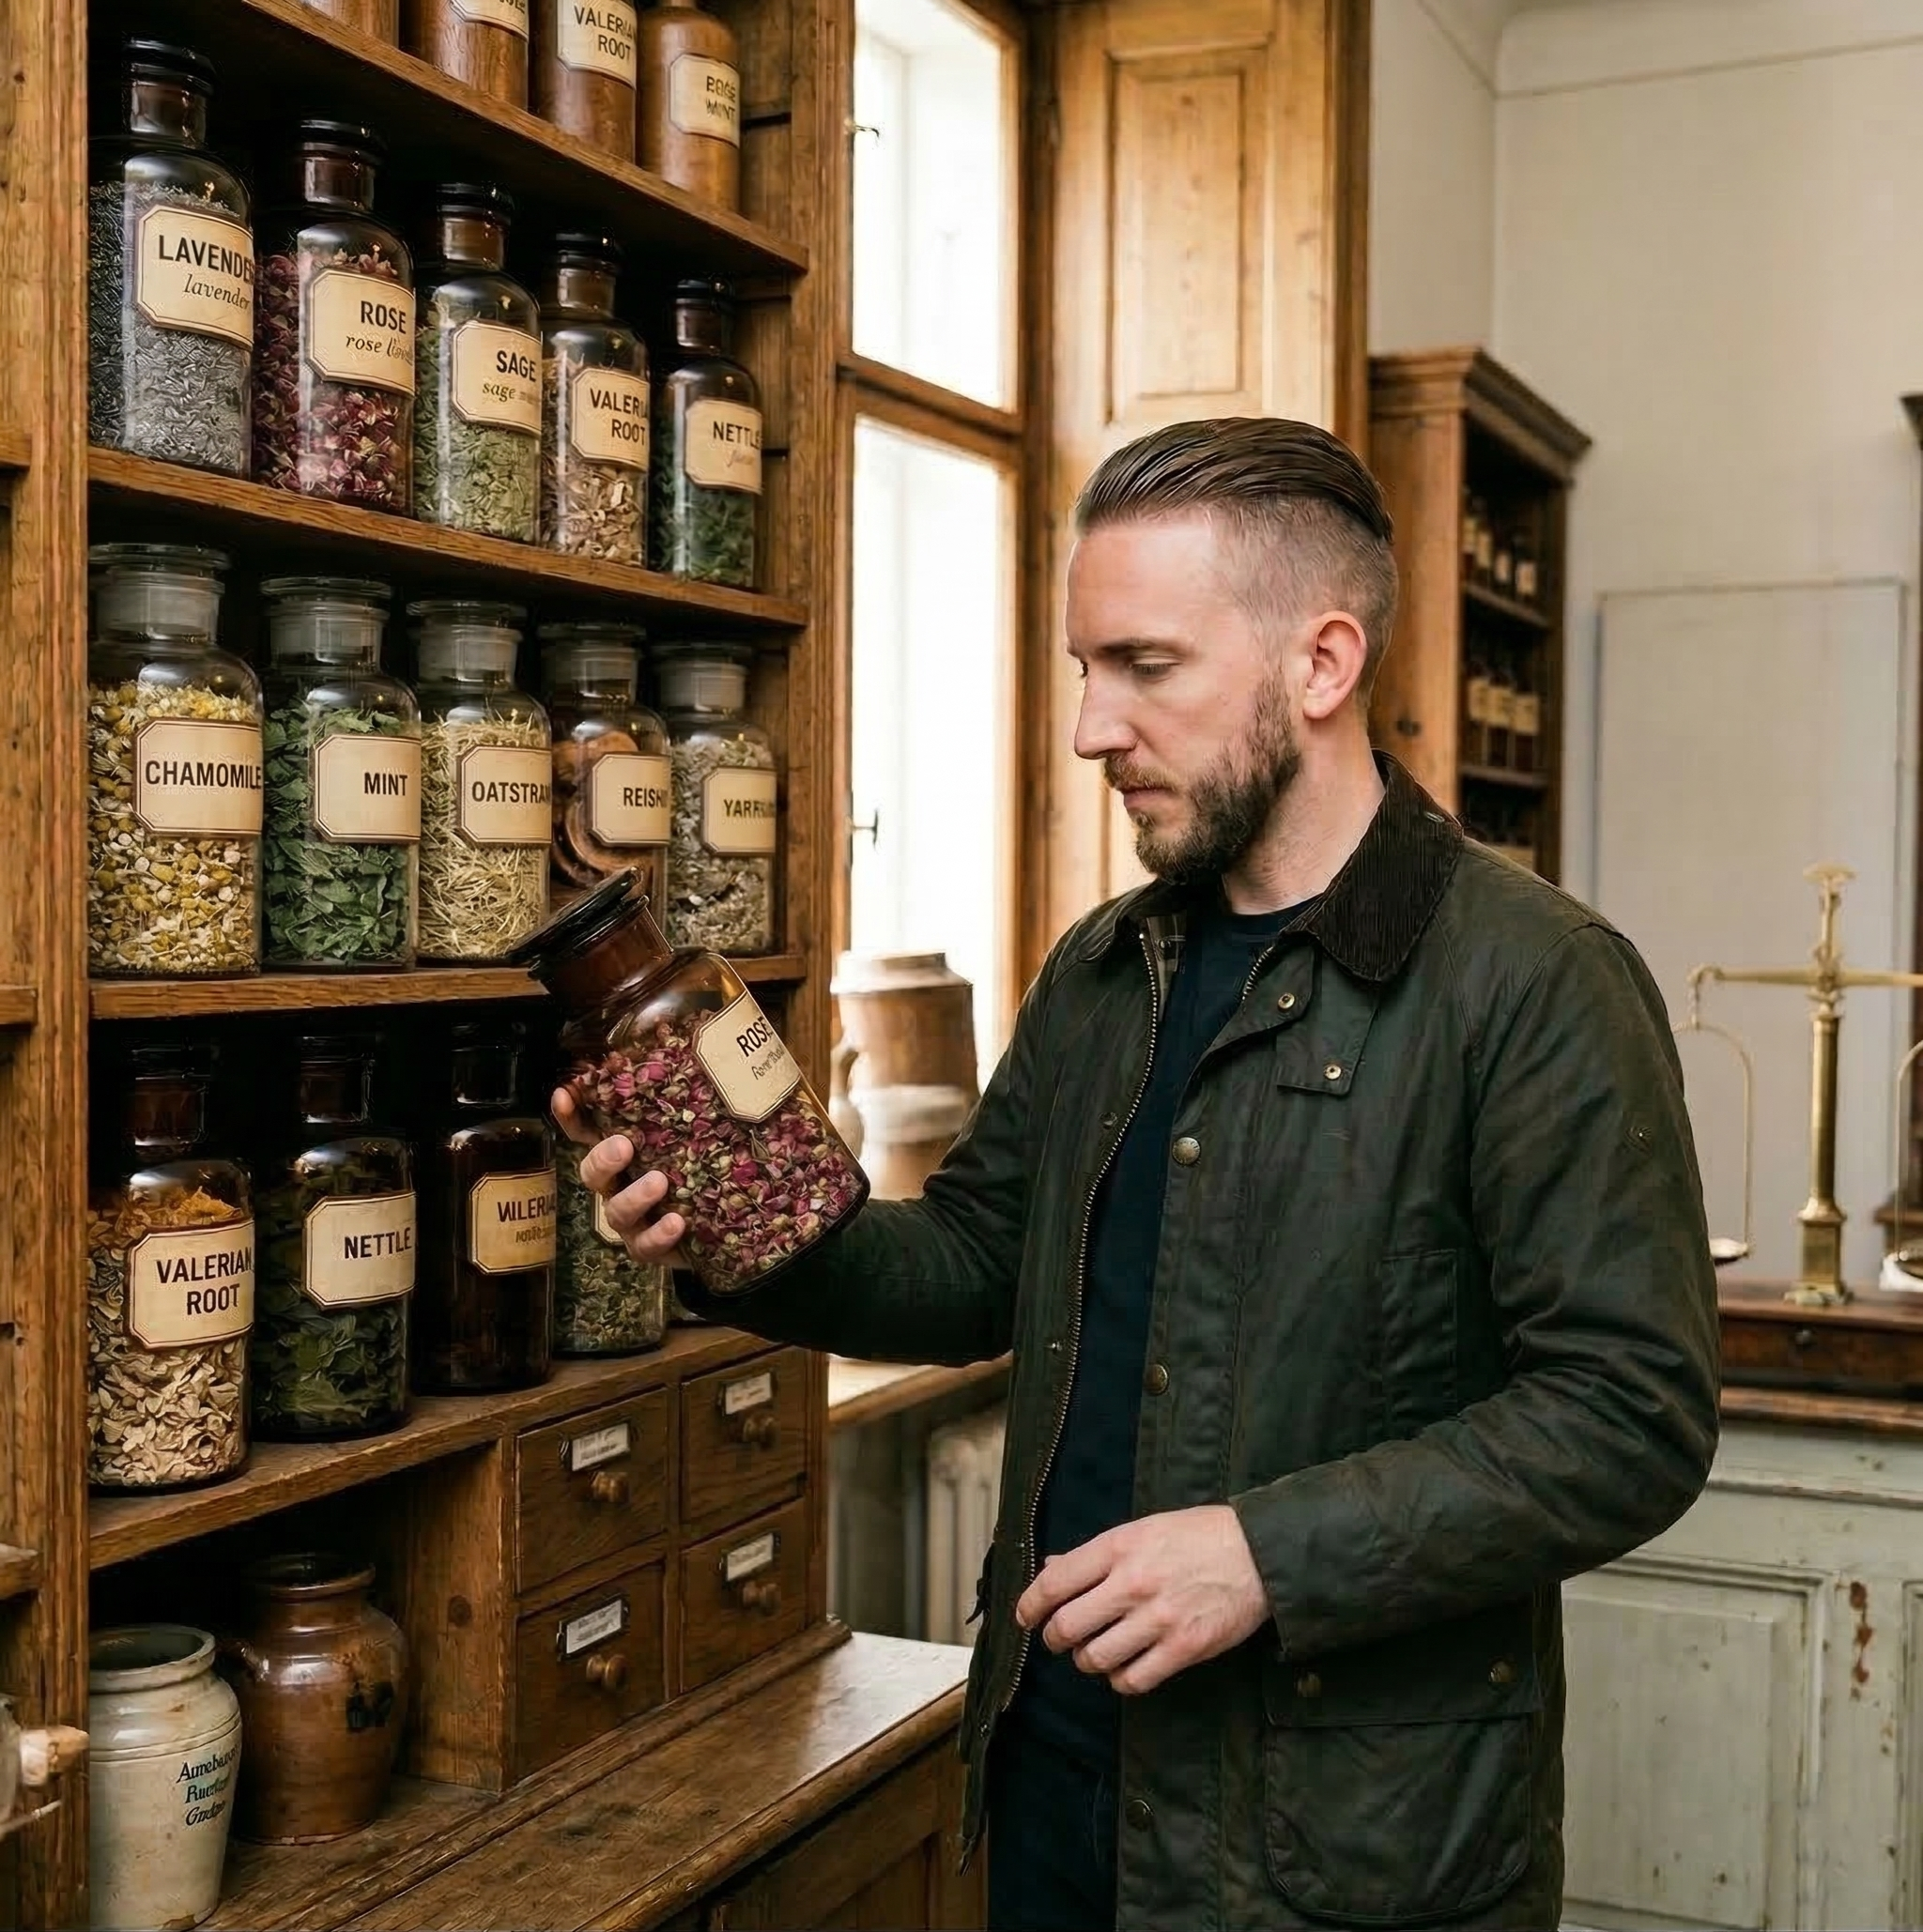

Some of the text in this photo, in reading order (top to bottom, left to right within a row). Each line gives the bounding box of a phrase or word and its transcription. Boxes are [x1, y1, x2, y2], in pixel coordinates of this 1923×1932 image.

[598, 34, 631, 60] ROOT
[183, 272, 251, 310] lavender
[361, 299, 407, 334] ROSE
[346, 335, 383, 353] rose
[496, 349, 536, 383] SAGE
[482, 382, 516, 403] sage
[611, 418, 646, 446] ROOT
[145, 759, 262, 790] CHAMOMILE
[363, 772, 408, 796] MINT
[736, 1016, 774, 1058] ROSE
[344, 1226, 412, 1260] NETTLE
[156, 1246, 252, 1284] VALERIAN
[187, 1282, 240, 1316] ROOT
